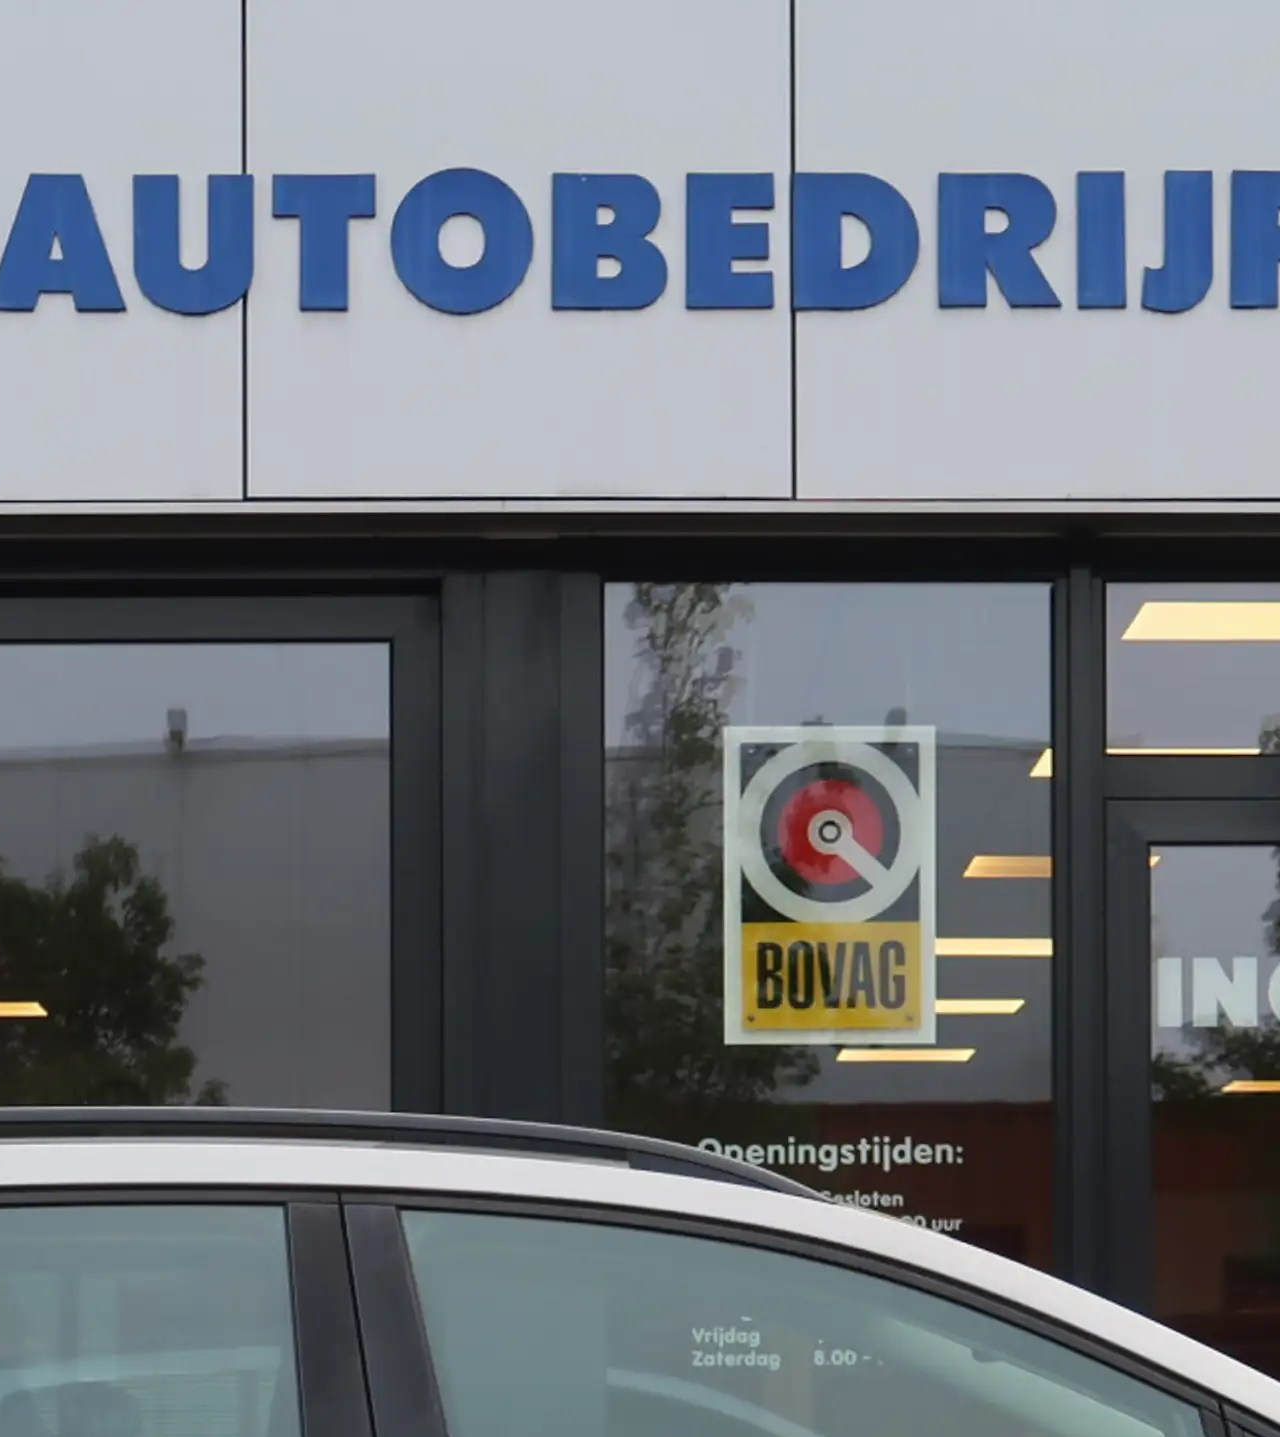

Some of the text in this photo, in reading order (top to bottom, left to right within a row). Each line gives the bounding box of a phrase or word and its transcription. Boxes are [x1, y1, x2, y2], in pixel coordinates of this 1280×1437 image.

[756, 939, 906, 1010] BOVAG
[931, 1218, 963, 1231] uur
[691, 1327, 761, 1348] Vrijdag
[691, 1350, 782, 1371] Zaterdag
